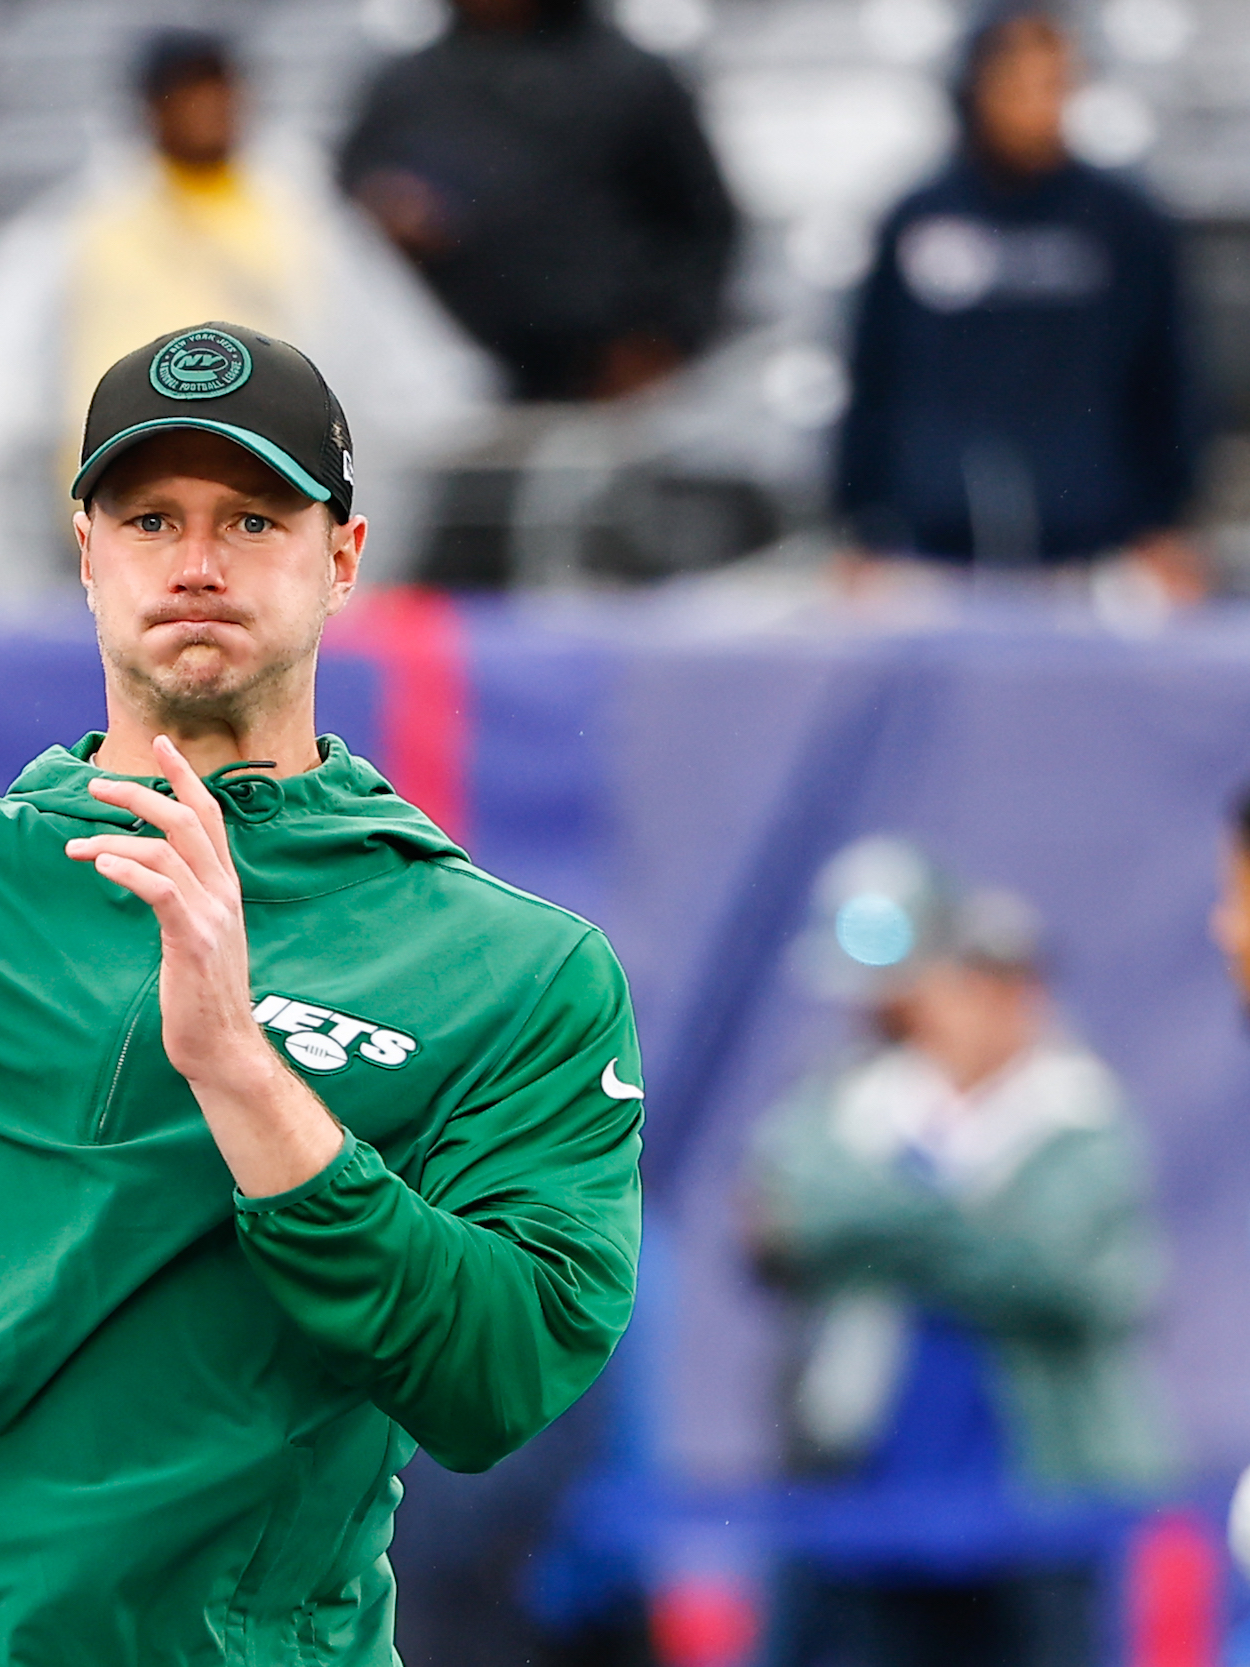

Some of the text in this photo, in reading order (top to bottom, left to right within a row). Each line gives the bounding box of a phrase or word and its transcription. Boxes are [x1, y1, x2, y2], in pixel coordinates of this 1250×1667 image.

[169, 334, 237, 353] NEW YORK JETS
[176, 354, 223, 368] NY
[179, 380, 225, 391] FOOTBALL
[250, 995, 417, 1065] JETS
